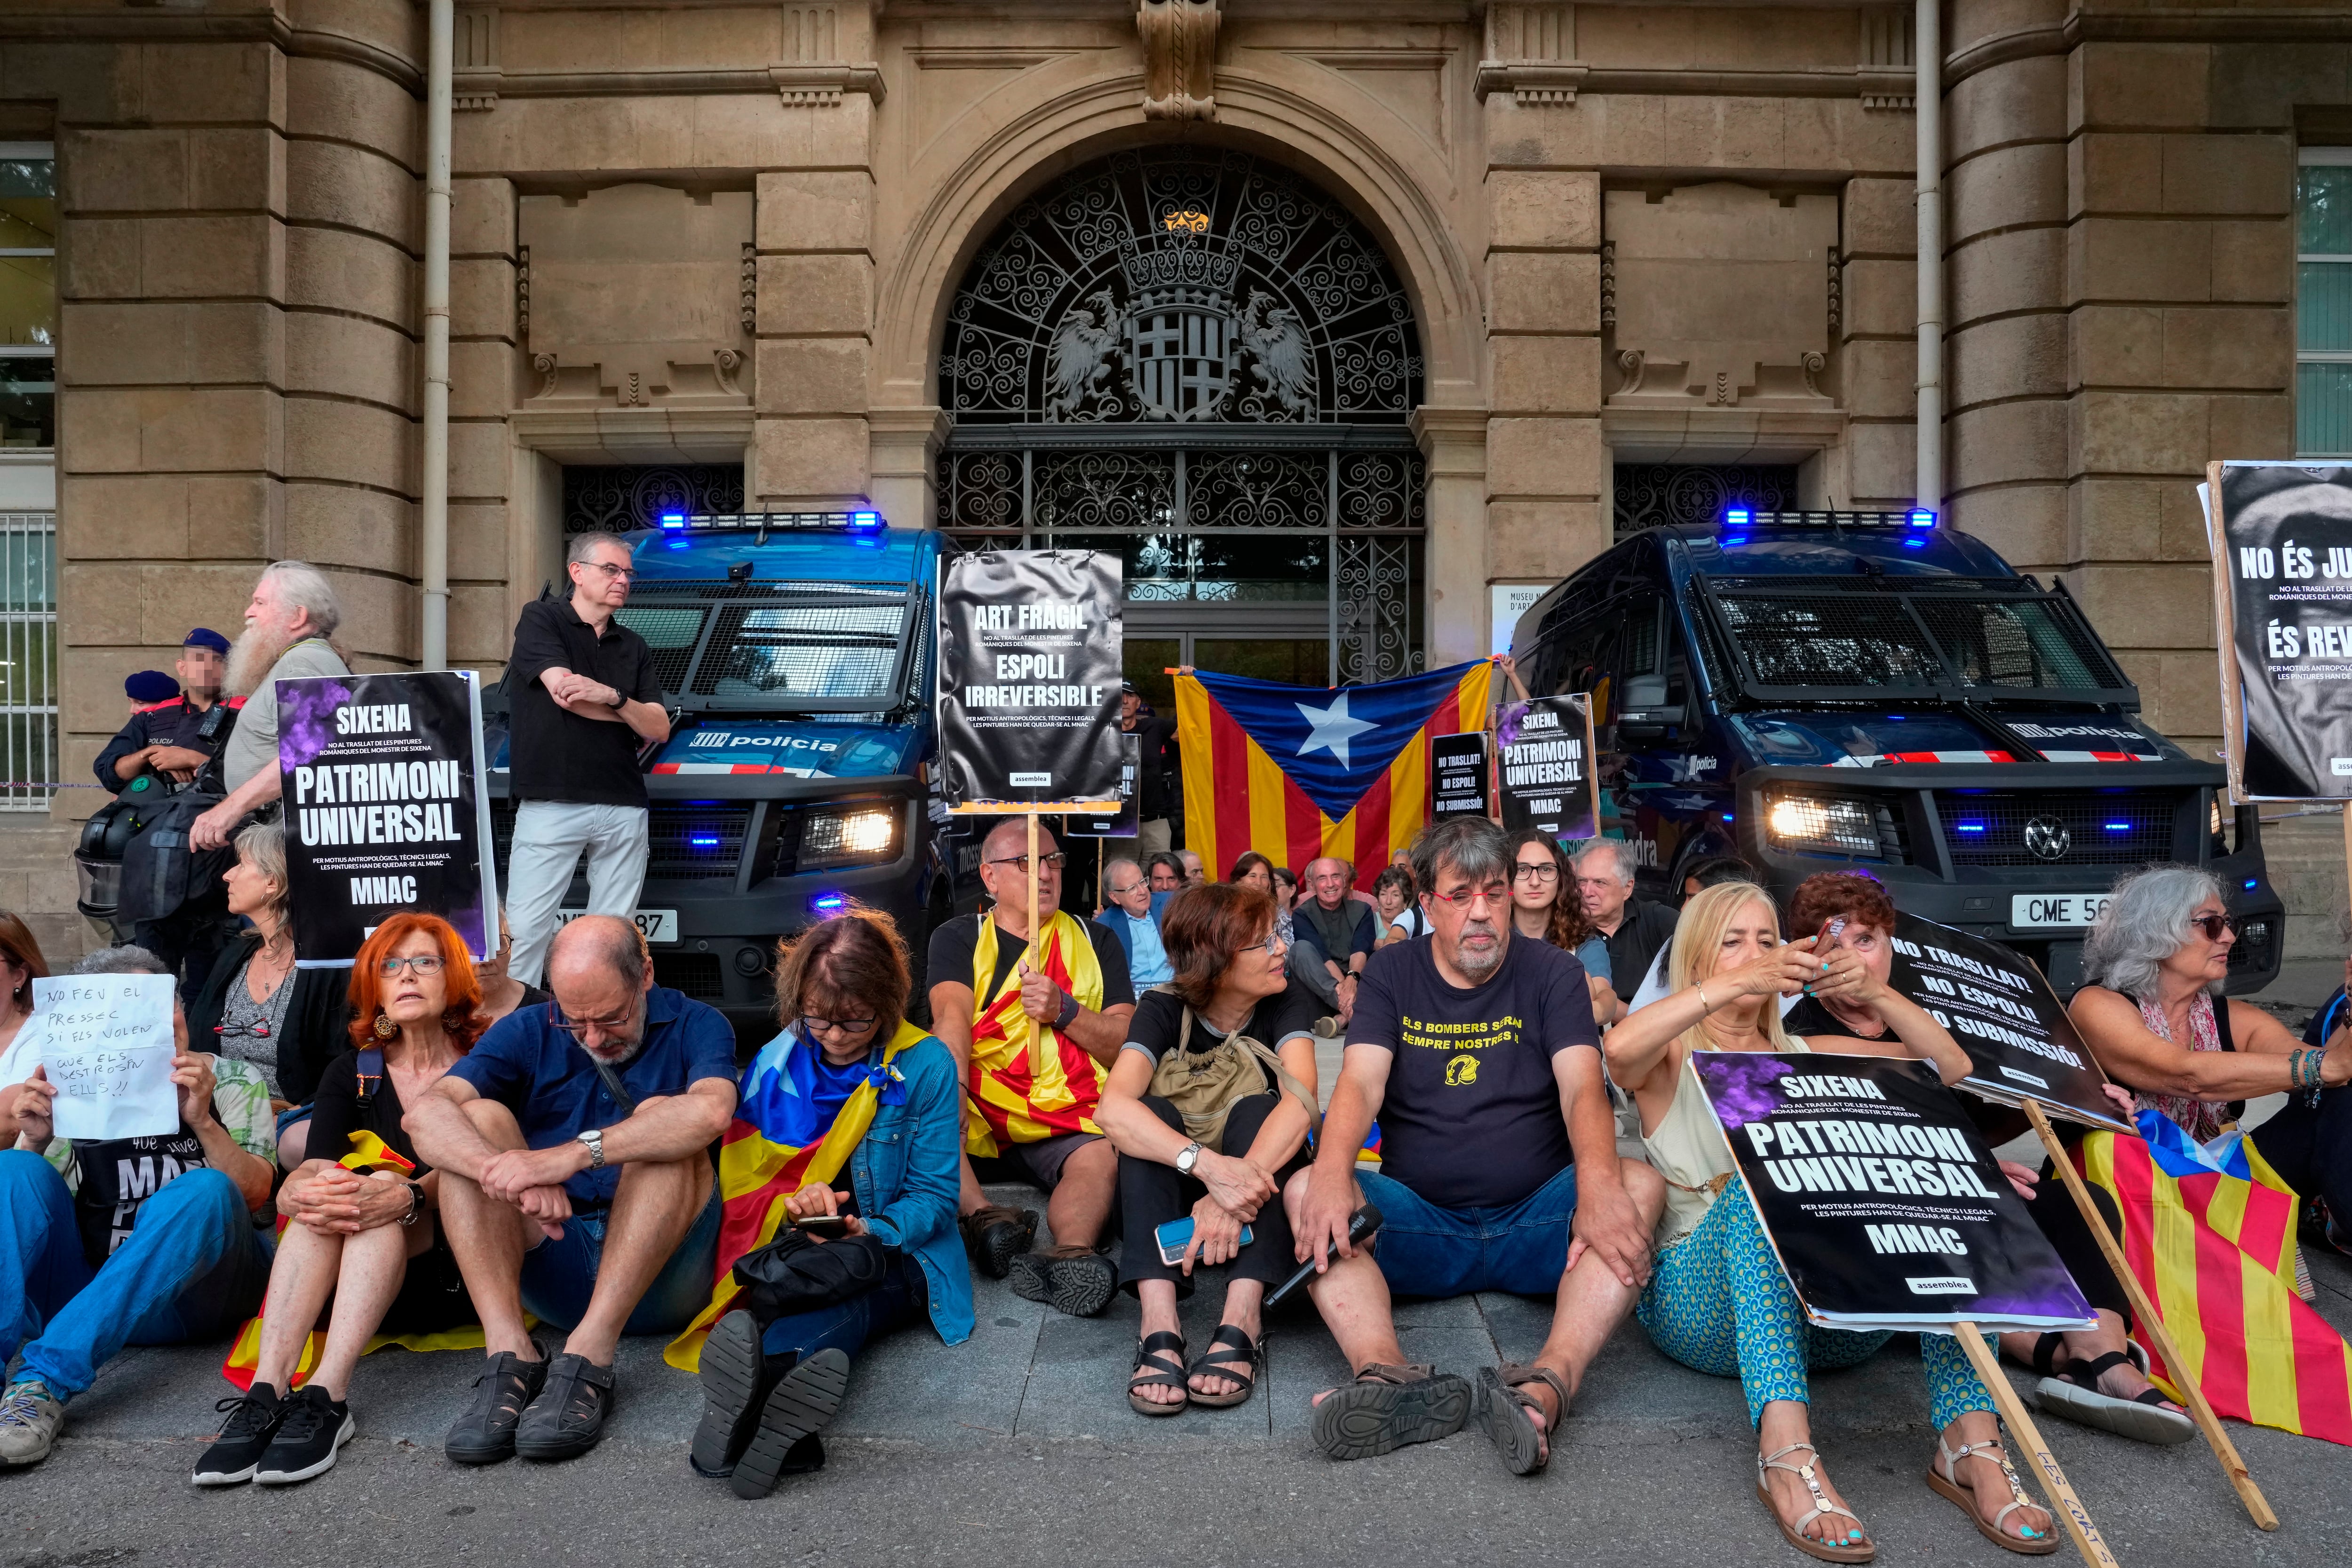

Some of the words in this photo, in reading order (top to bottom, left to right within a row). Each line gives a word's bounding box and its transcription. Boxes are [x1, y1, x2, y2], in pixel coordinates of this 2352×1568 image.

[2240, 548, 2274, 579] NO
[2282, 539, 2314, 579] ÉS
[974, 605, 1012, 630] ART
[1019, 600, 1088, 629] FRÀGIL
[2267, 618, 2300, 658] ÉS
[997, 654, 1064, 679] ESPOLI
[966, 685, 1102, 707] IRREVERSIBLE
[336, 704, 412, 734] SIXENA
[1523, 712, 1558, 730] SIXENA
[729, 735, 838, 752] policia
[2052, 726, 2145, 740] policia
[1438, 757, 1446, 768] NO
[1448, 753, 1480, 767] TRASLLAT!
[1504, 739, 1581, 765] PATRIMONI
[1696, 756, 1717, 772] policia
[295, 760, 459, 804] PATRIMONI
[1442, 778, 1451, 789] NO
[1452, 776, 1476, 788] ESPOLI!
[1506, 761, 1581, 786] UNIVERSAL
[1436, 801, 1445, 812] NO
[1446, 796, 1483, 811] SUBMISSIÓ!
[1530, 798, 1562, 814] MNAC
[299, 803, 461, 846] UNIVERSAL
[350, 876, 417, 905] MNAC
[2029, 899, 2071, 923] CME
[1891, 936, 1922, 958] NO
[1923, 945, 2034, 994] TRASLLAT!
[48, 990, 65, 1003] NO
[73, 988, 105, 1000] FEU
[124, 988, 141, 997] EL
[1921, 975, 1955, 996] NO
[1958, 983, 2041, 1025] ESPOLI!
[48, 1011, 119, 1027] PRESSEC
[1403, 1016, 1422, 1030] ELS
[1425, 1022, 1488, 1034] BOMBERS
[1492, 1016, 1522, 1031] SERAN
[73, 1031, 92, 1042] ELS
[103, 1025, 151, 1039] VOLEN
[1402, 1031, 1450, 1050] SEMPRE
[1455, 1031, 1511, 1050] NOSTRES
[1953, 1016, 2086, 1071] SUBMISSIÓ!
[97, 1052, 126, 1063] ELS
[1780, 1075, 1887, 1100] SIXENA
[2007, 1070, 2042, 1084] assemblea
[1743, 1120, 1977, 1163] PATRIMONI
[1763, 1156, 2000, 1199] UNIVERSAL
[1853, 1203, 1925, 1212] ANTROPOLÒGICS,
[1905, 1211, 1952, 1220] QUEDAR-SE
[1864, 1224, 1968, 1255] MNAC
[2037, 1452, 2066, 1486] LES
[2063, 1498, 2114, 1563] CORTS
